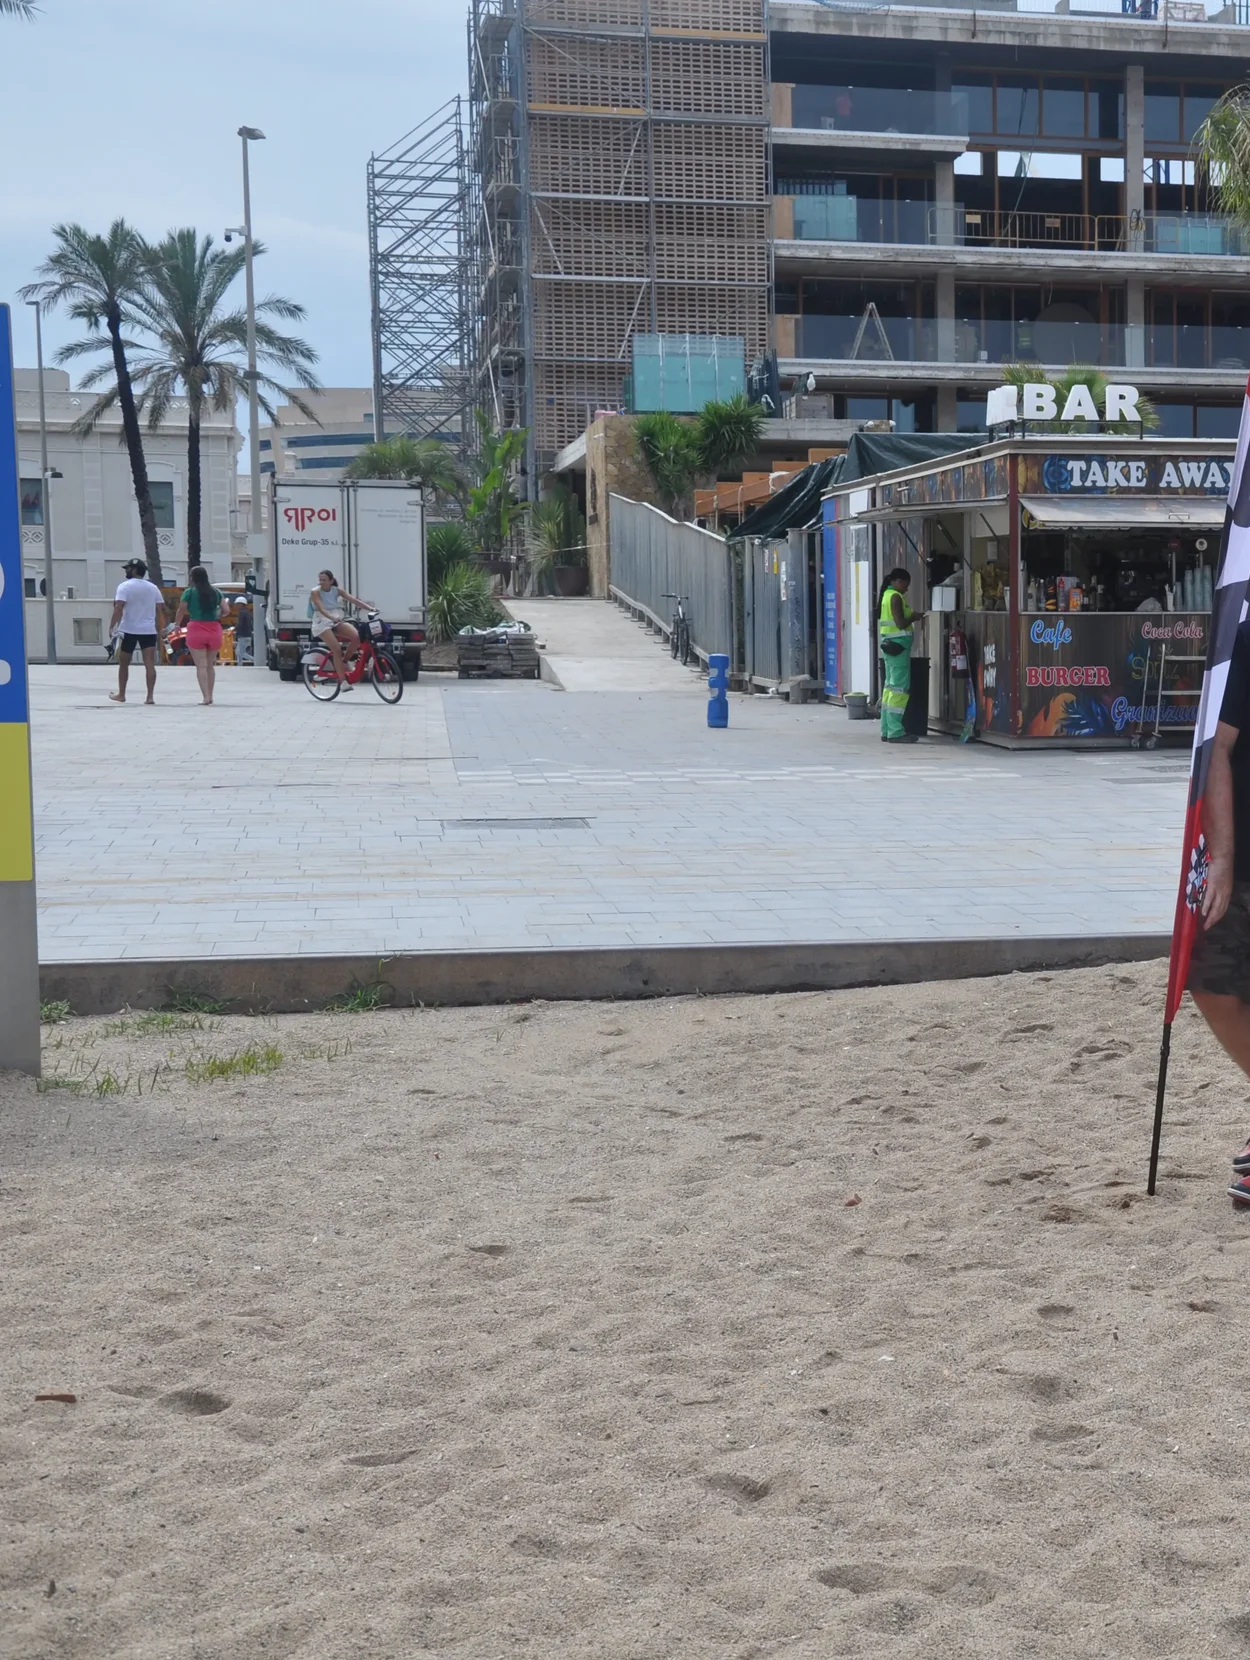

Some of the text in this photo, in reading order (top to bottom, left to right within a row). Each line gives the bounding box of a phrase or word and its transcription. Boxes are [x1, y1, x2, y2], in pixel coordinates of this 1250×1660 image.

[1023, 383, 1142, 421] BAR
[1066, 460, 1147, 487] TAKE
[301, 538, 330, 546] Grup-35
[1030, 619, 1072, 650] Cafe
[1141, 621, 1203, 639] Coca Cola
[1026, 666, 1111, 687] BURGER
